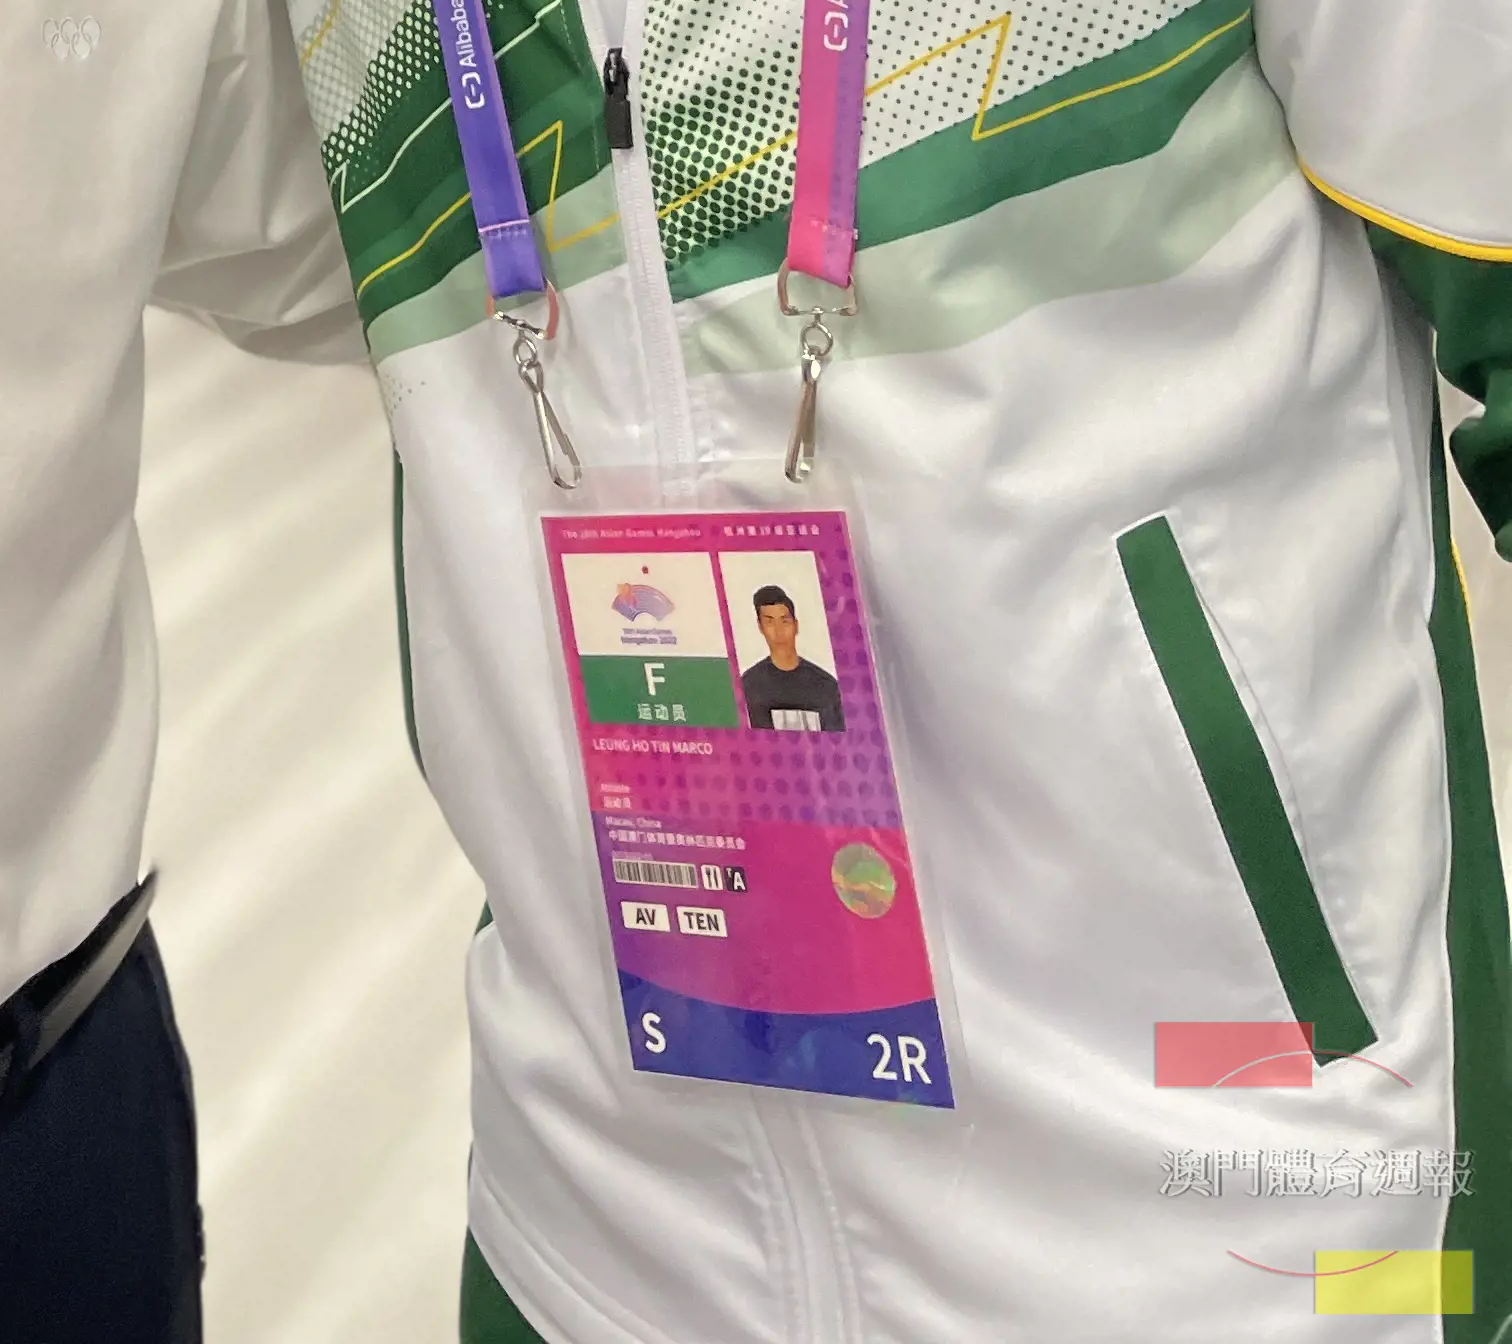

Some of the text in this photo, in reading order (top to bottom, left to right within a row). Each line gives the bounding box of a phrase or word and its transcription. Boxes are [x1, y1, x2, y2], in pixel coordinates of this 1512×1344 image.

[644, 662, 665, 696] F
[638, 703, 686, 722] 运动员
[592, 738, 630, 752] LEUNG
[632, 740, 649, 752] HO
[672, 741, 713, 755] MARCO
[636, 908, 720, 931] AV TEN
[641, 1012, 932, 1084] S 2R
